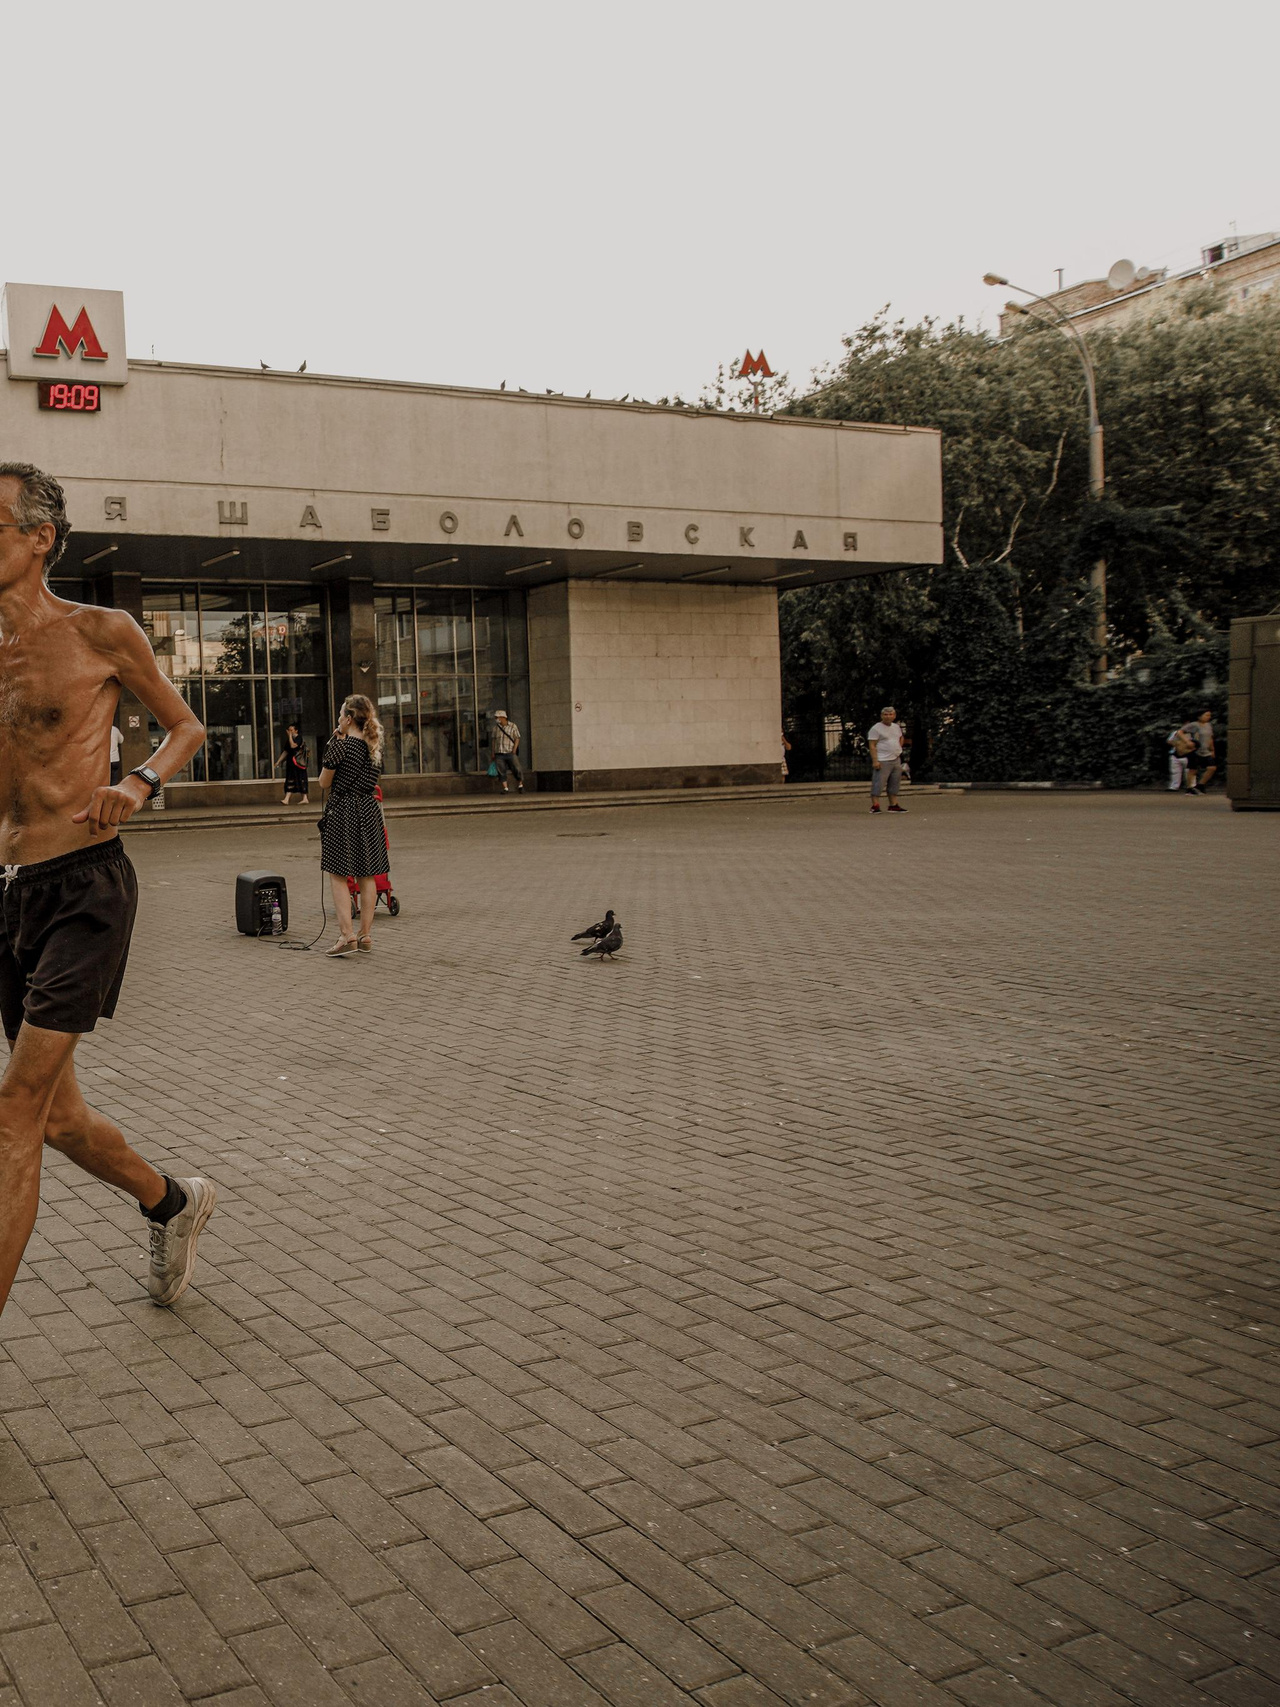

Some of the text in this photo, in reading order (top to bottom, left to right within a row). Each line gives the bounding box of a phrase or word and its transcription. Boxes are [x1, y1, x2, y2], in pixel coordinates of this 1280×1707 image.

[33, 303, 108, 361] М
[739, 348, 775, 377] М
[50, 384, 99, 410] 19:09
[218, 501, 858, 551] ШАБОЛОВСКАЯ
